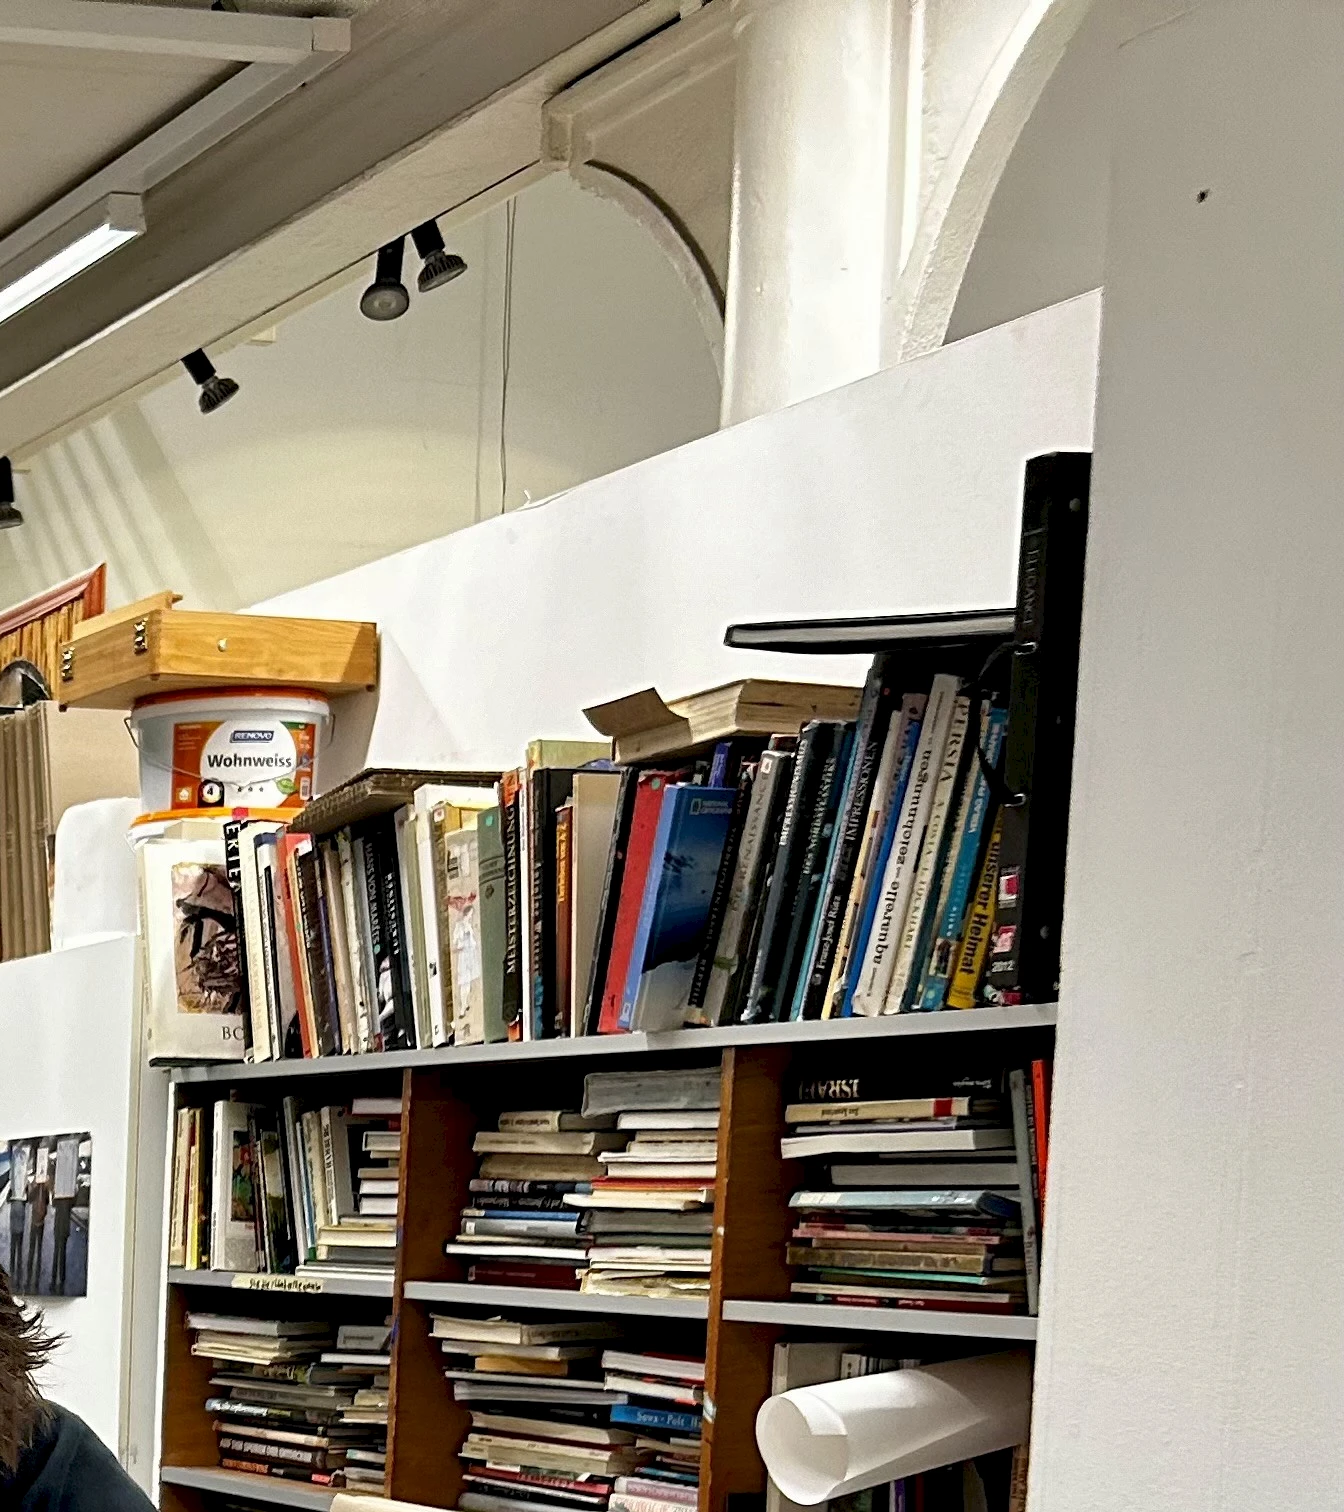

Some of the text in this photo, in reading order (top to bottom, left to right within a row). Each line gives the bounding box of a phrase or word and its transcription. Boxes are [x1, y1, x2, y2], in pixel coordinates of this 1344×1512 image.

[234, 732, 273, 741] RENOVO
[207, 753, 292, 769] Wohnweiss
[207, 785, 214, 796] 4
[846, 740, 877, 842] IMPRESSIONEN
[873, 749, 933, 966] aquarelle zeichnungen
[960, 909, 990, 977] Heimat
